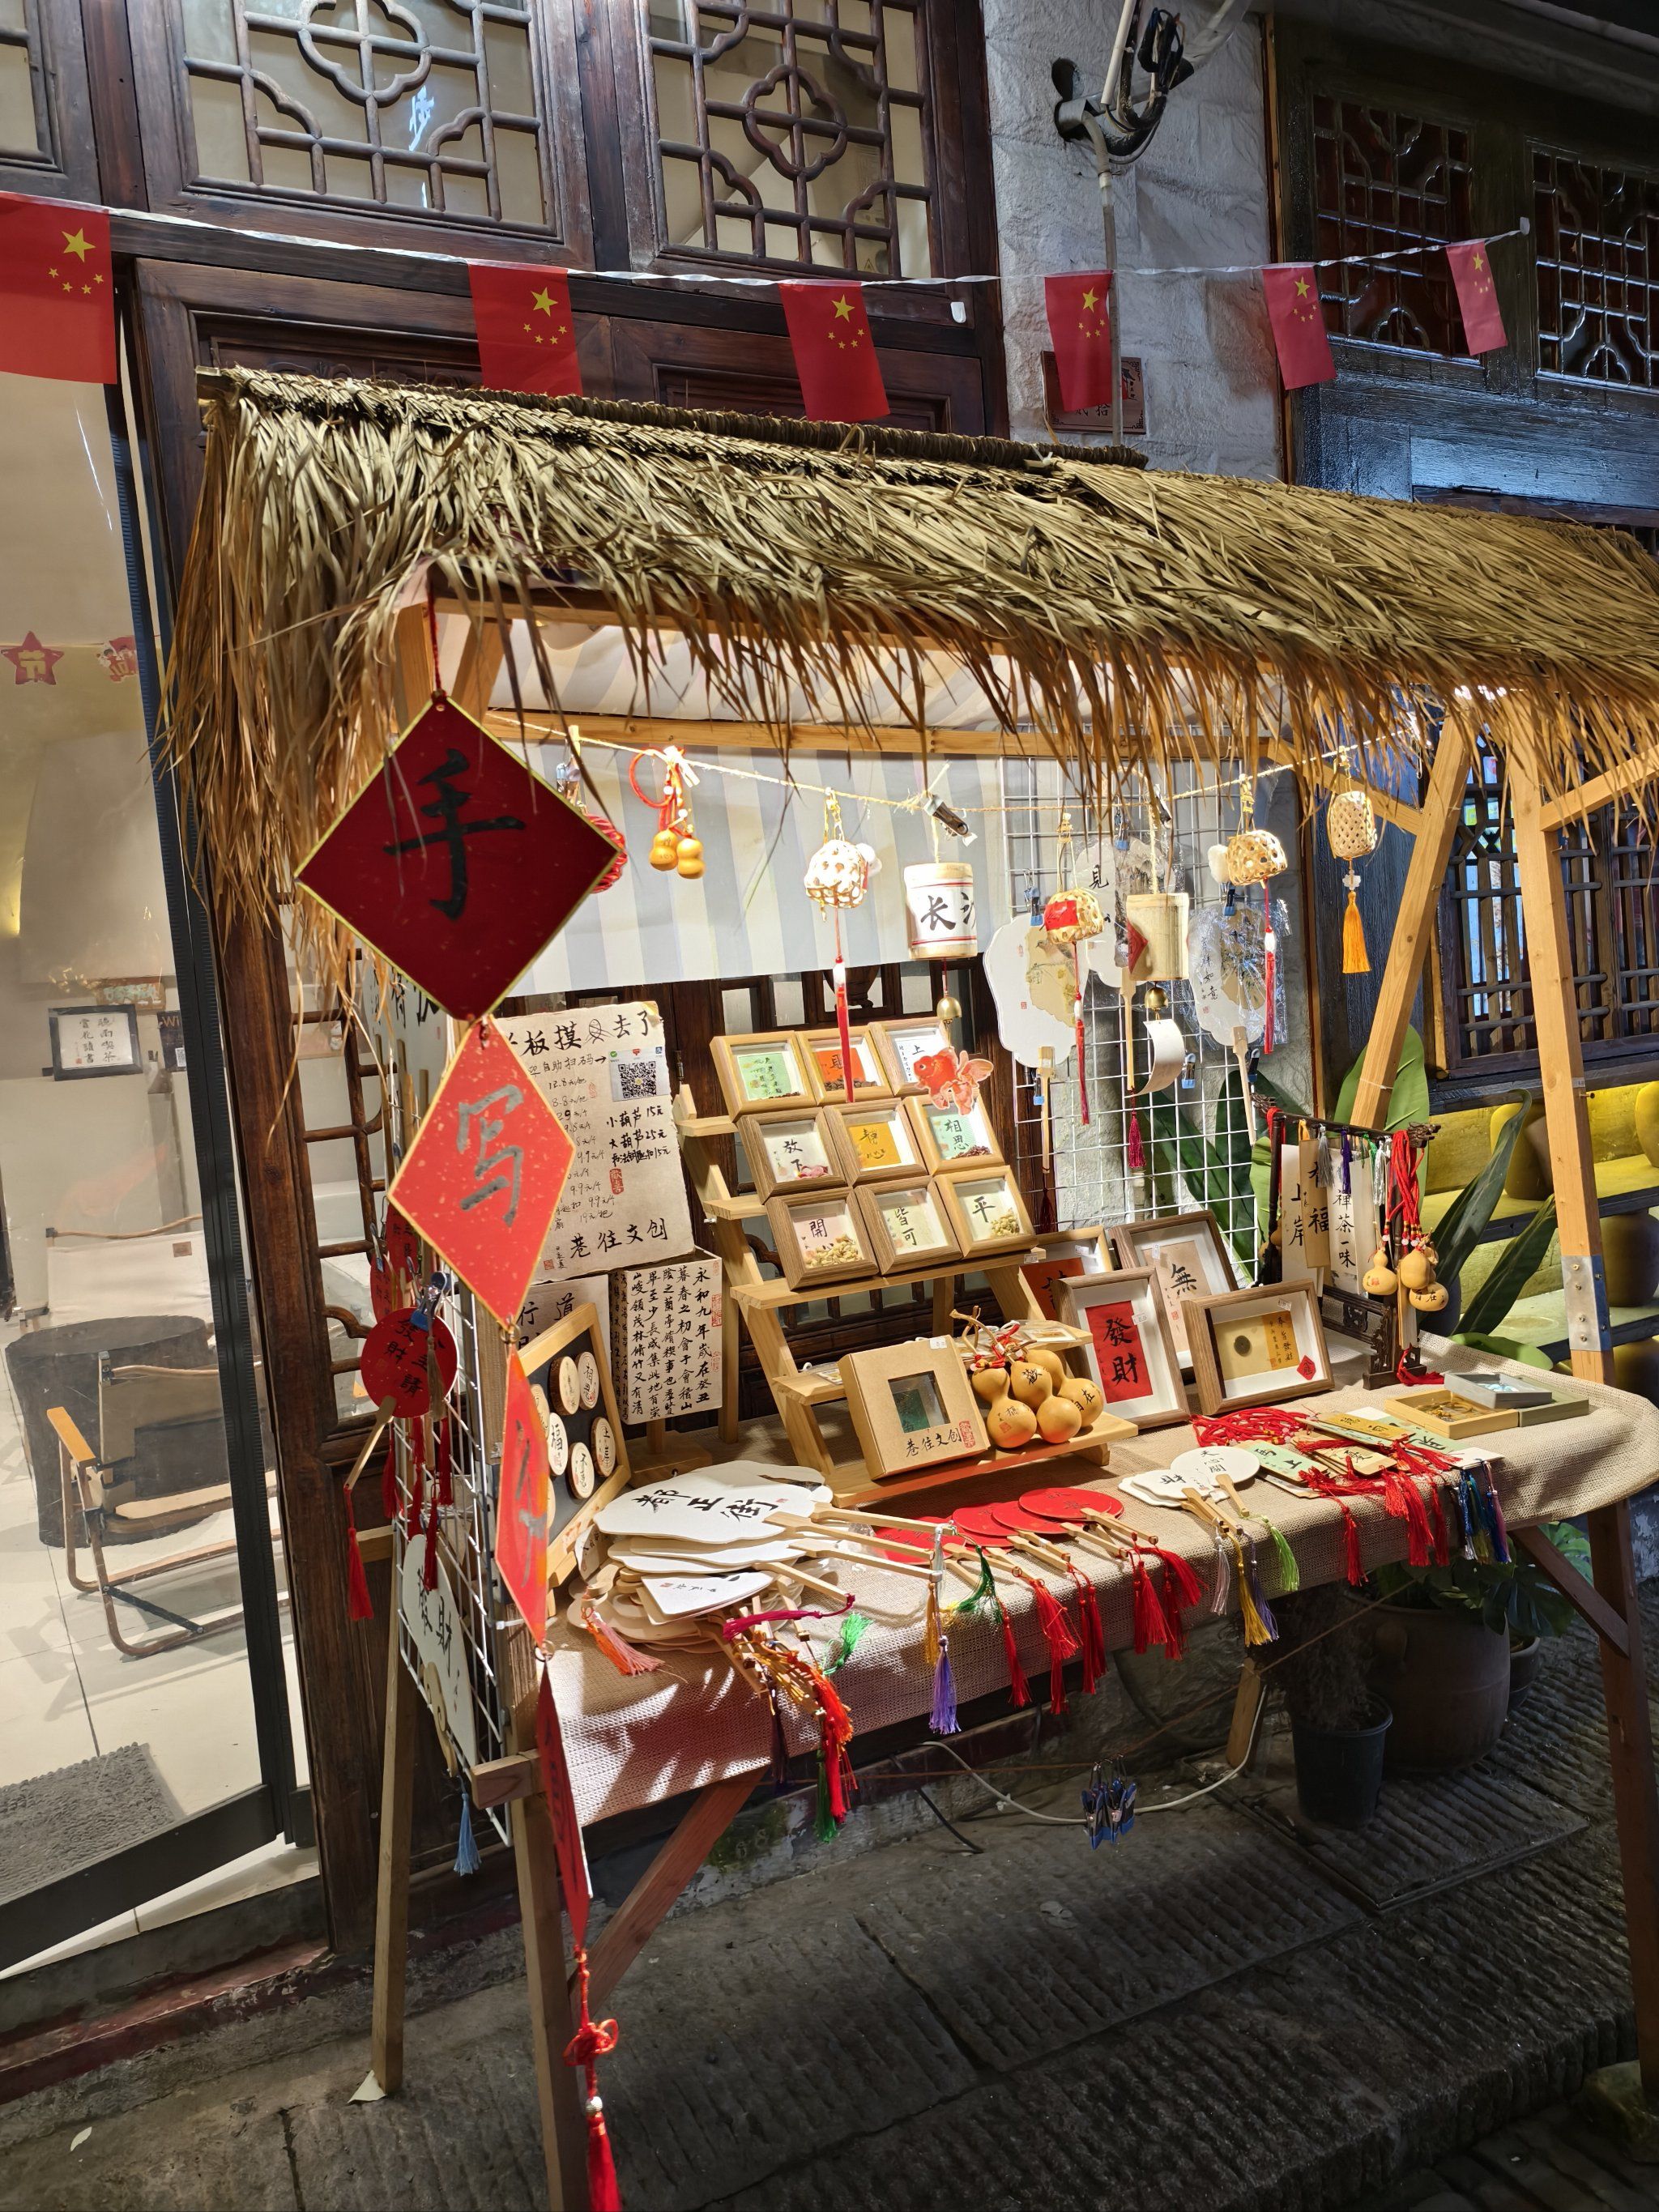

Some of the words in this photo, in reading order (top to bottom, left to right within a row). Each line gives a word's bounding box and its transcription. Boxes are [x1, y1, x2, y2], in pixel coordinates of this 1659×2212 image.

[382, 748, 527, 921] 手
[783, 1138, 804, 1173] 放下
[943, 1119, 970, 1151] 相思
[456, 1084, 524, 1228] 写
[894, 1206, 918, 1247] 皆可
[971, 1196, 996, 1224] 平
[1333, 1190, 1356, 1268] 禪茶一味
[569, 1217, 669, 1259] 巷往文创
[1170, 1263, 1198, 1295] 無
[1102, 1317, 1139, 1387] 發財
[905, 1428, 962, 1458] 巷往文创
